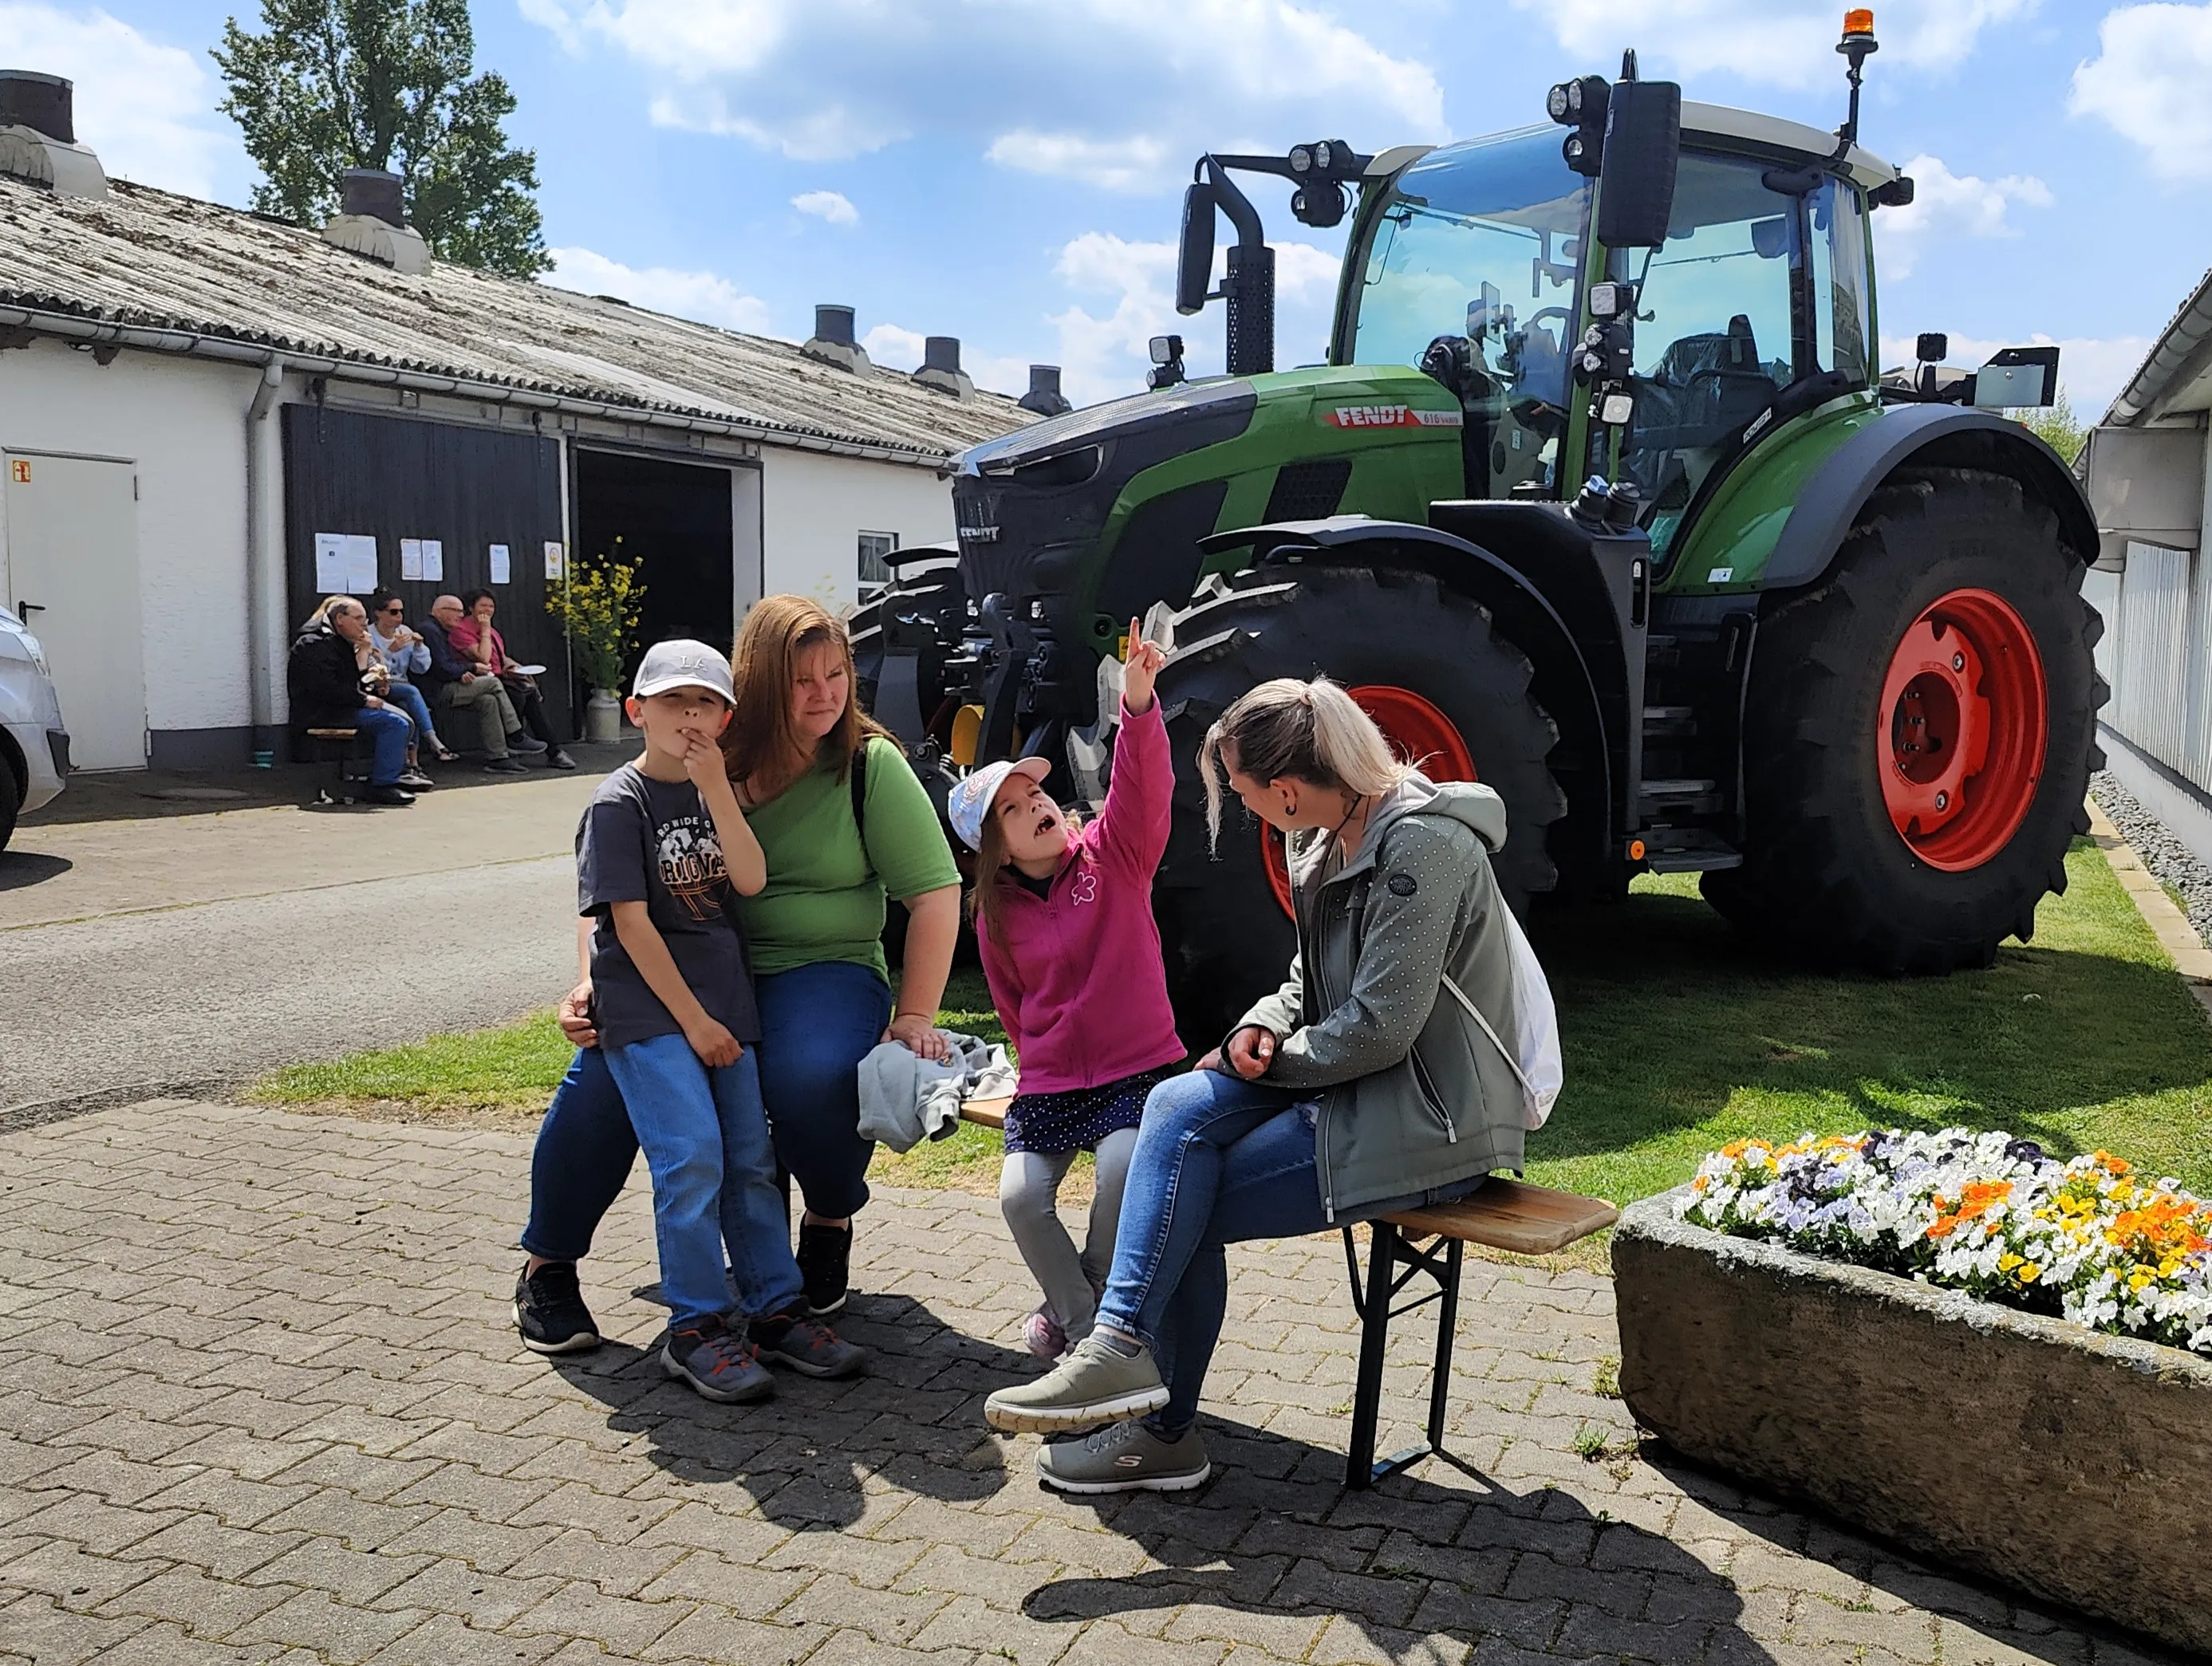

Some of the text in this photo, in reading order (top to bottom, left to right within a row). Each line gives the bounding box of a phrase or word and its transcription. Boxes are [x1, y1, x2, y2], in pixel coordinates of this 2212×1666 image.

[1335, 405, 1408, 426] FENDT
[960, 526, 1000, 542] FENDT
[680, 655, 708, 672] LA
[672, 817, 700, 828] WIDE
